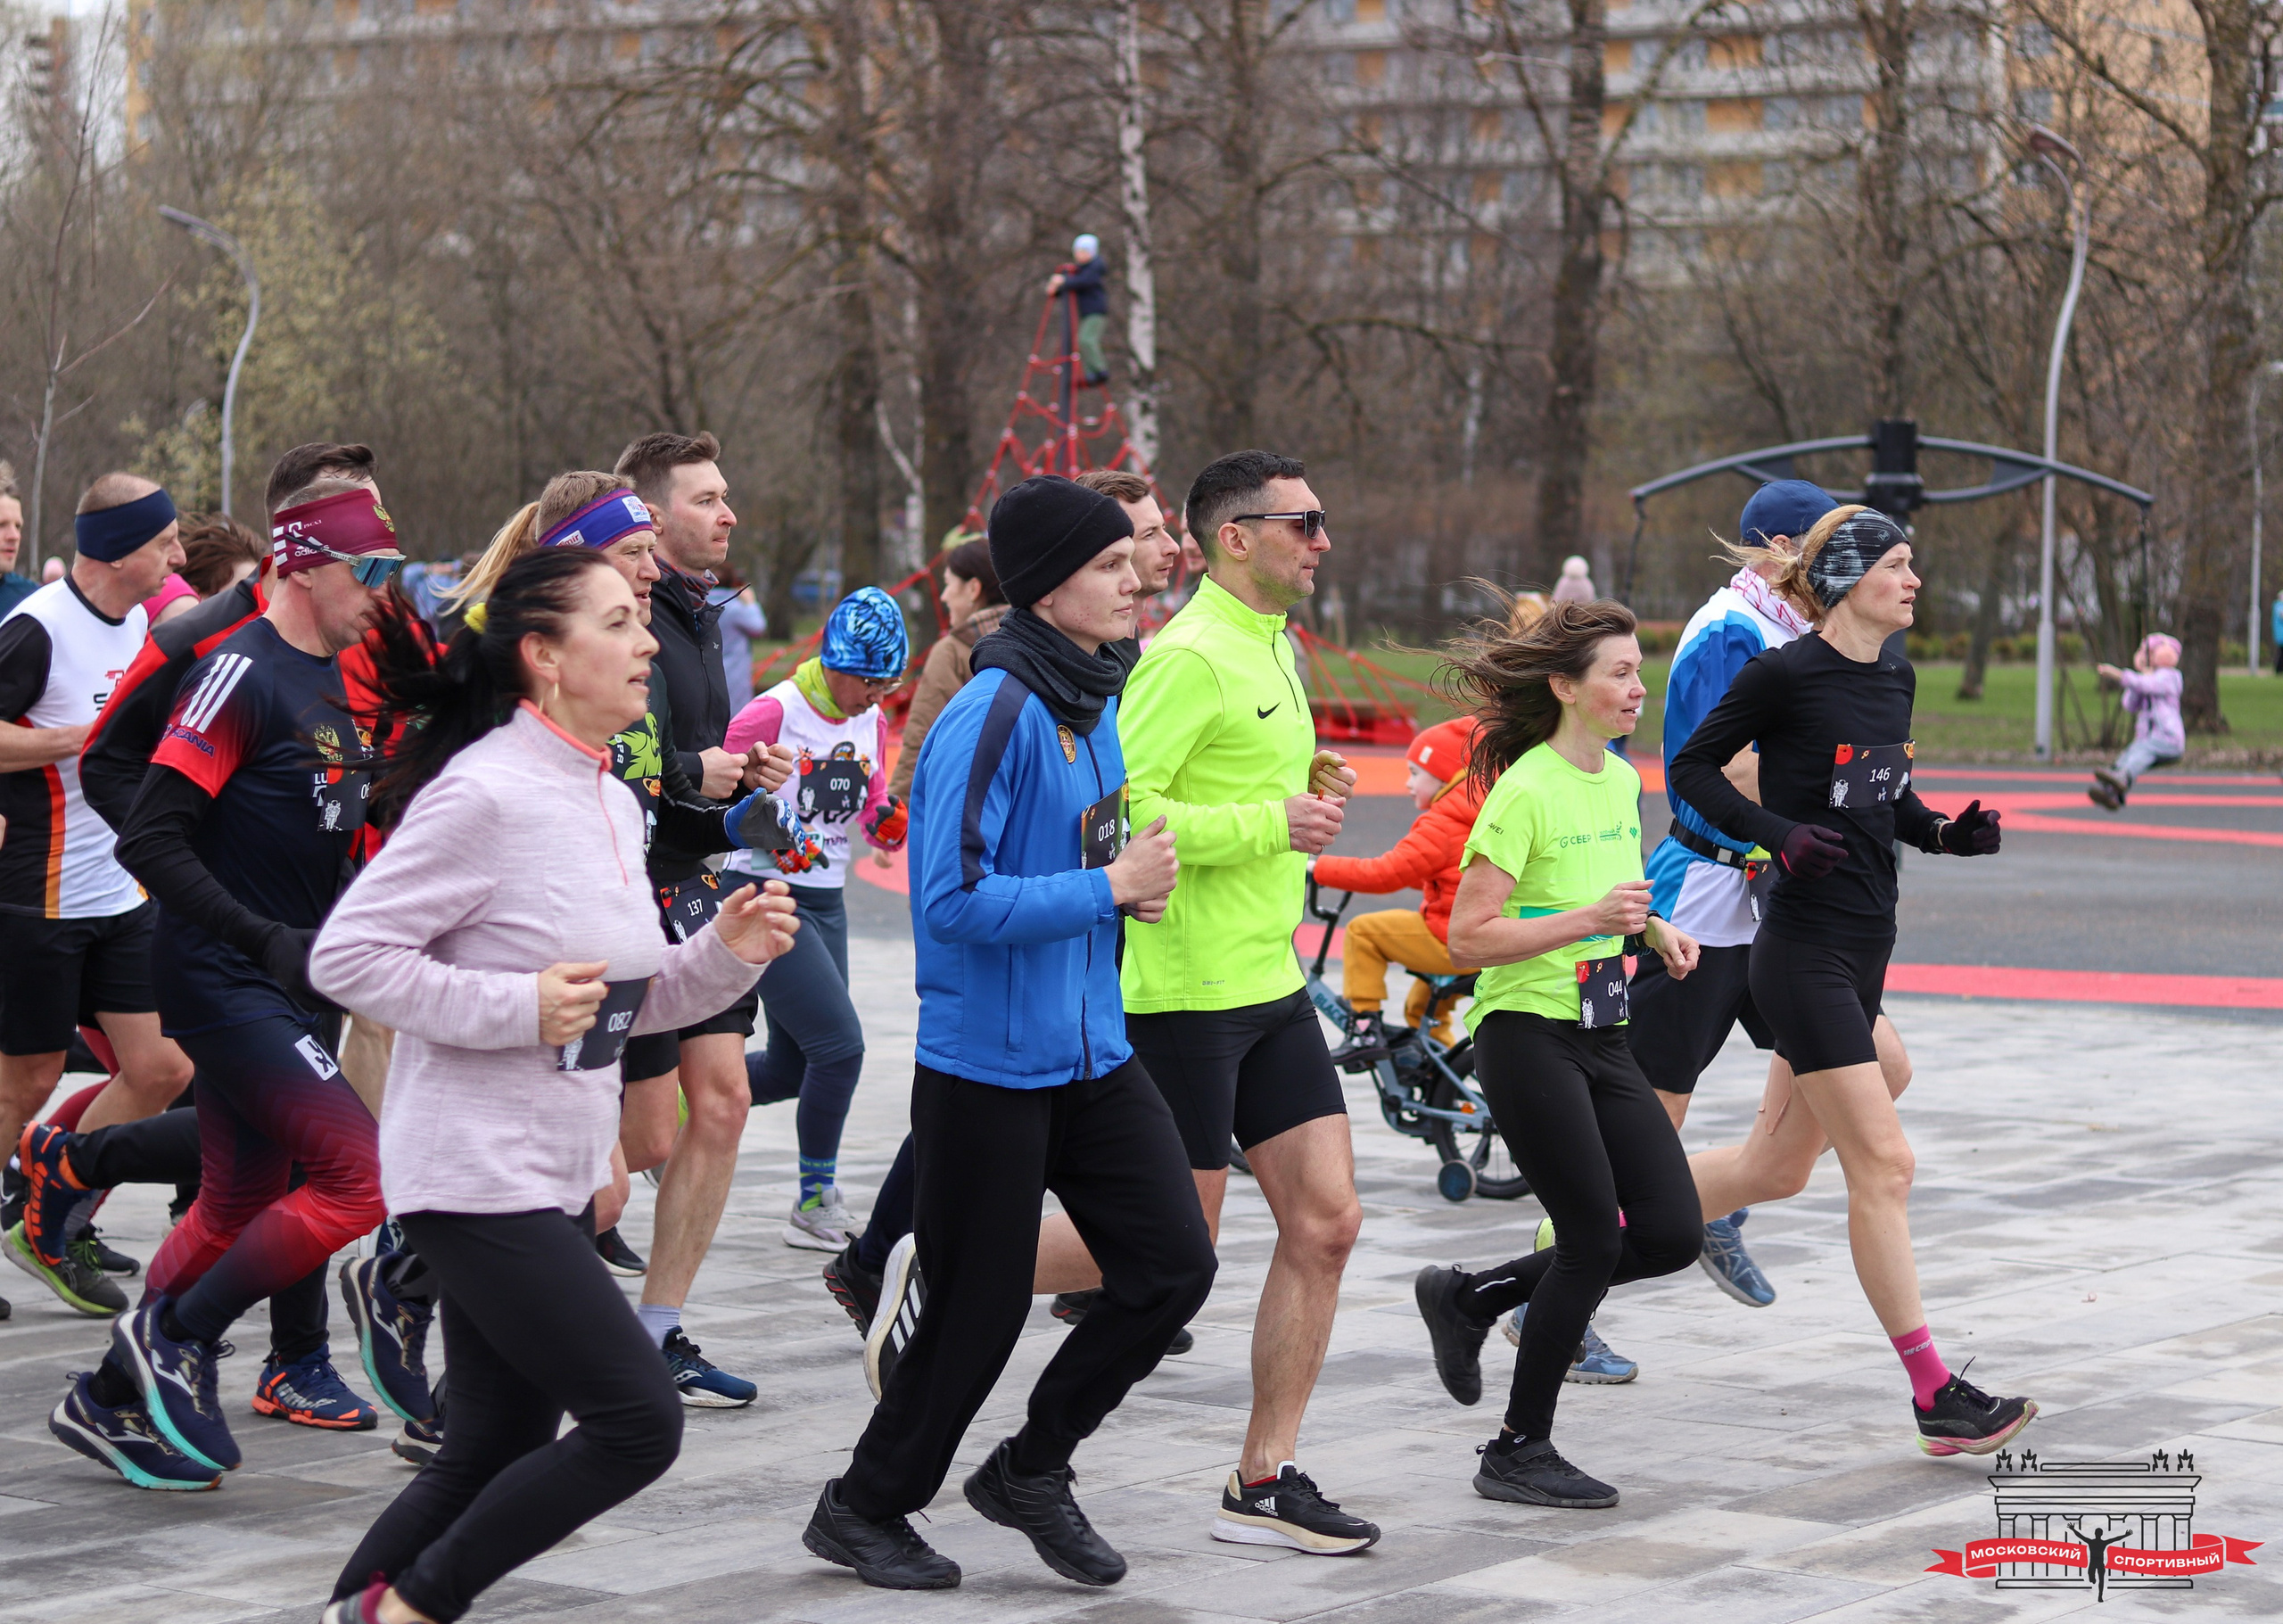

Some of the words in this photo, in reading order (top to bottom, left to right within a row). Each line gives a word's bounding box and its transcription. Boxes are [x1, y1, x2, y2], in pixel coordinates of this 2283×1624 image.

[171, 729, 215, 758] SCANIA
[1869, 767, 1891, 782] 146
[830, 778, 851, 791] 070
[1098, 819, 1116, 842] 018
[687, 898, 704, 917] 137
[1608, 979, 1623, 997] 044
[607, 1010, 633, 1033] 082
